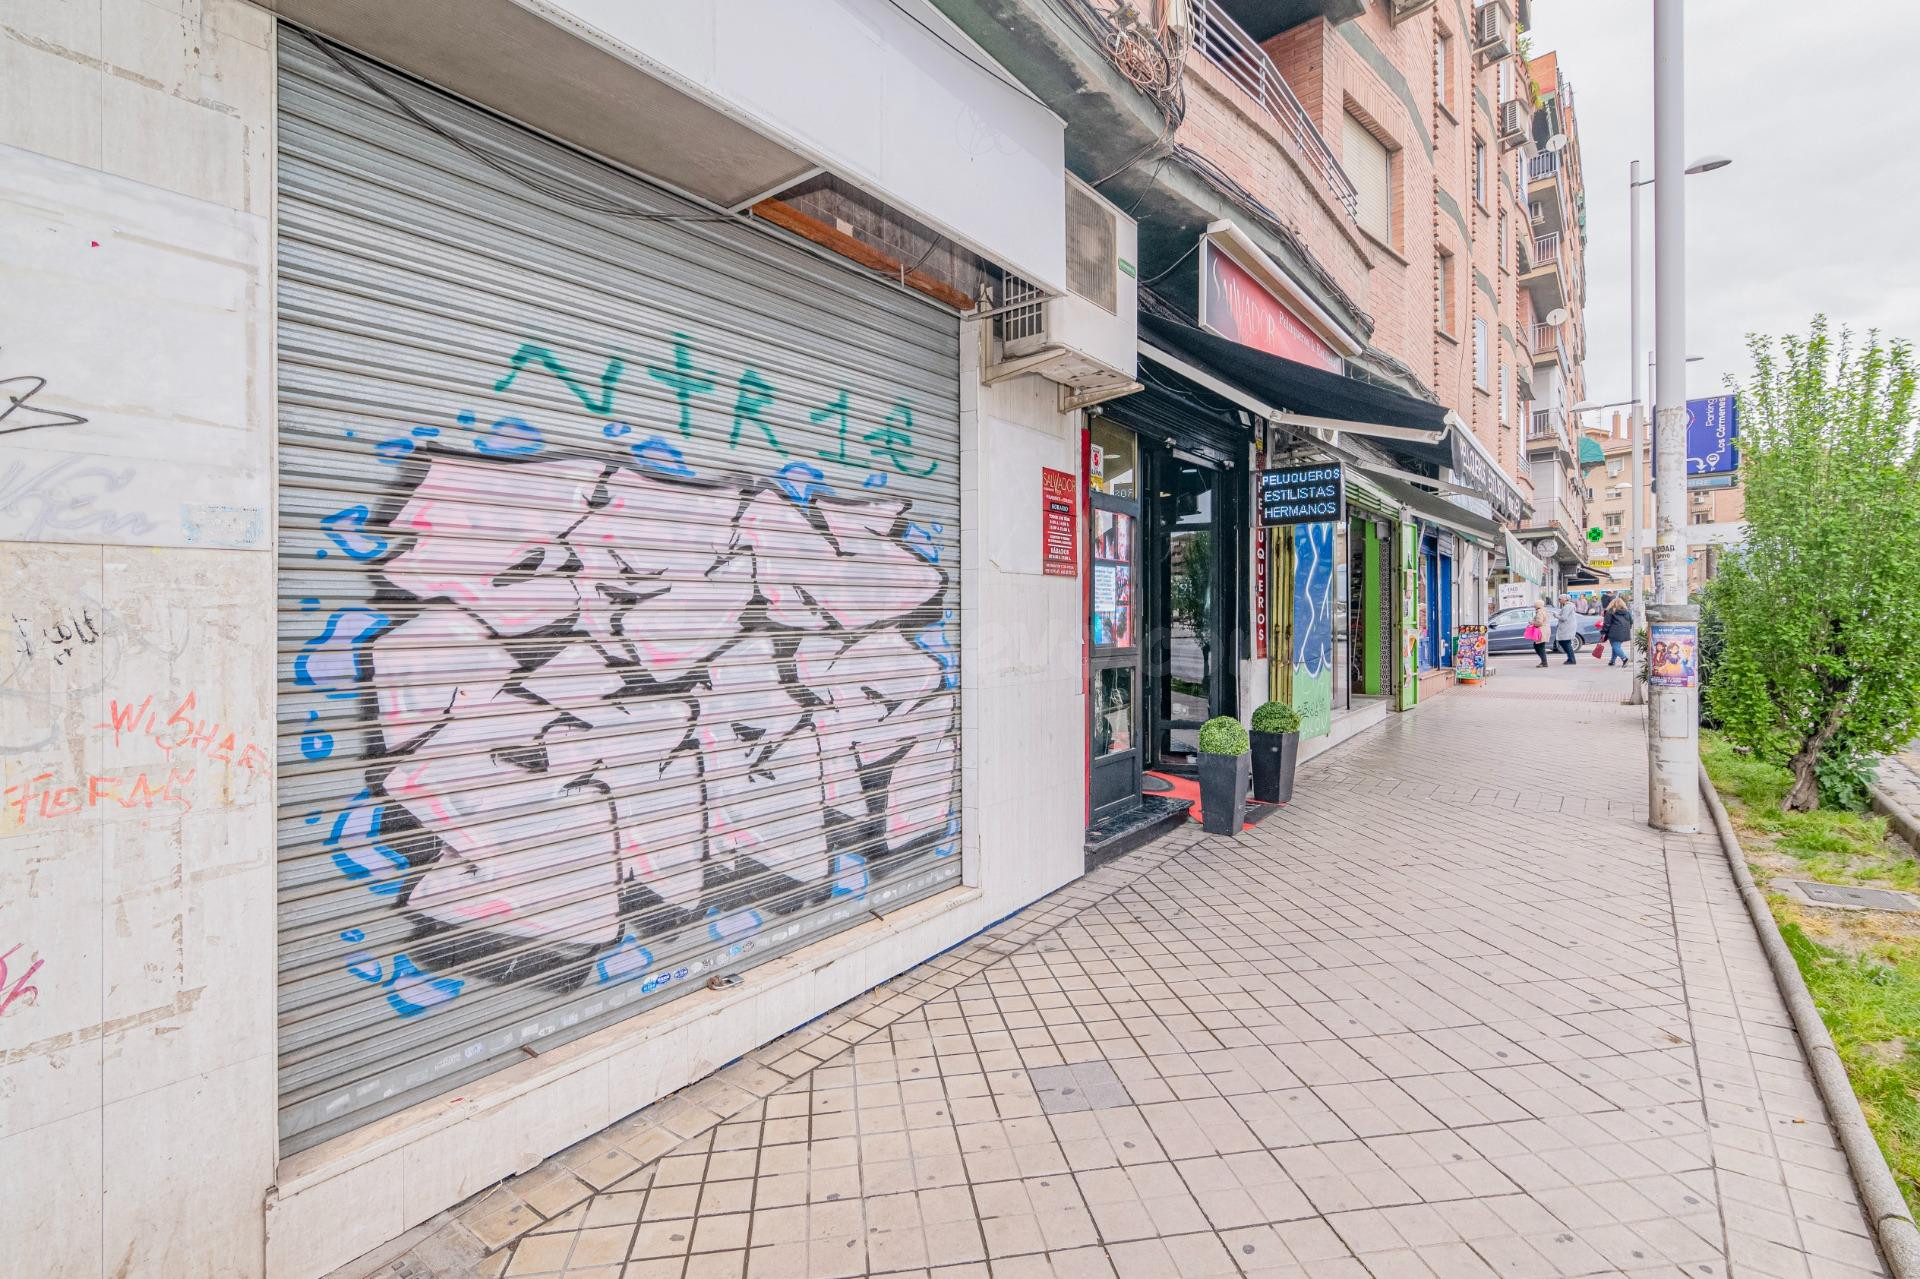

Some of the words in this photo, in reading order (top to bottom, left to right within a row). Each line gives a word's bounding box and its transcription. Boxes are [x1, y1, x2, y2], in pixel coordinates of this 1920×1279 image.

[1705, 397, 1717, 427] Parking
[1716, 441, 1726, 453] Los
[1262, 468, 1340, 486] PELUQUEROS
[1264, 485, 1336, 502] ESTILISTAS
[1264, 502, 1336, 519] HERMANOS
